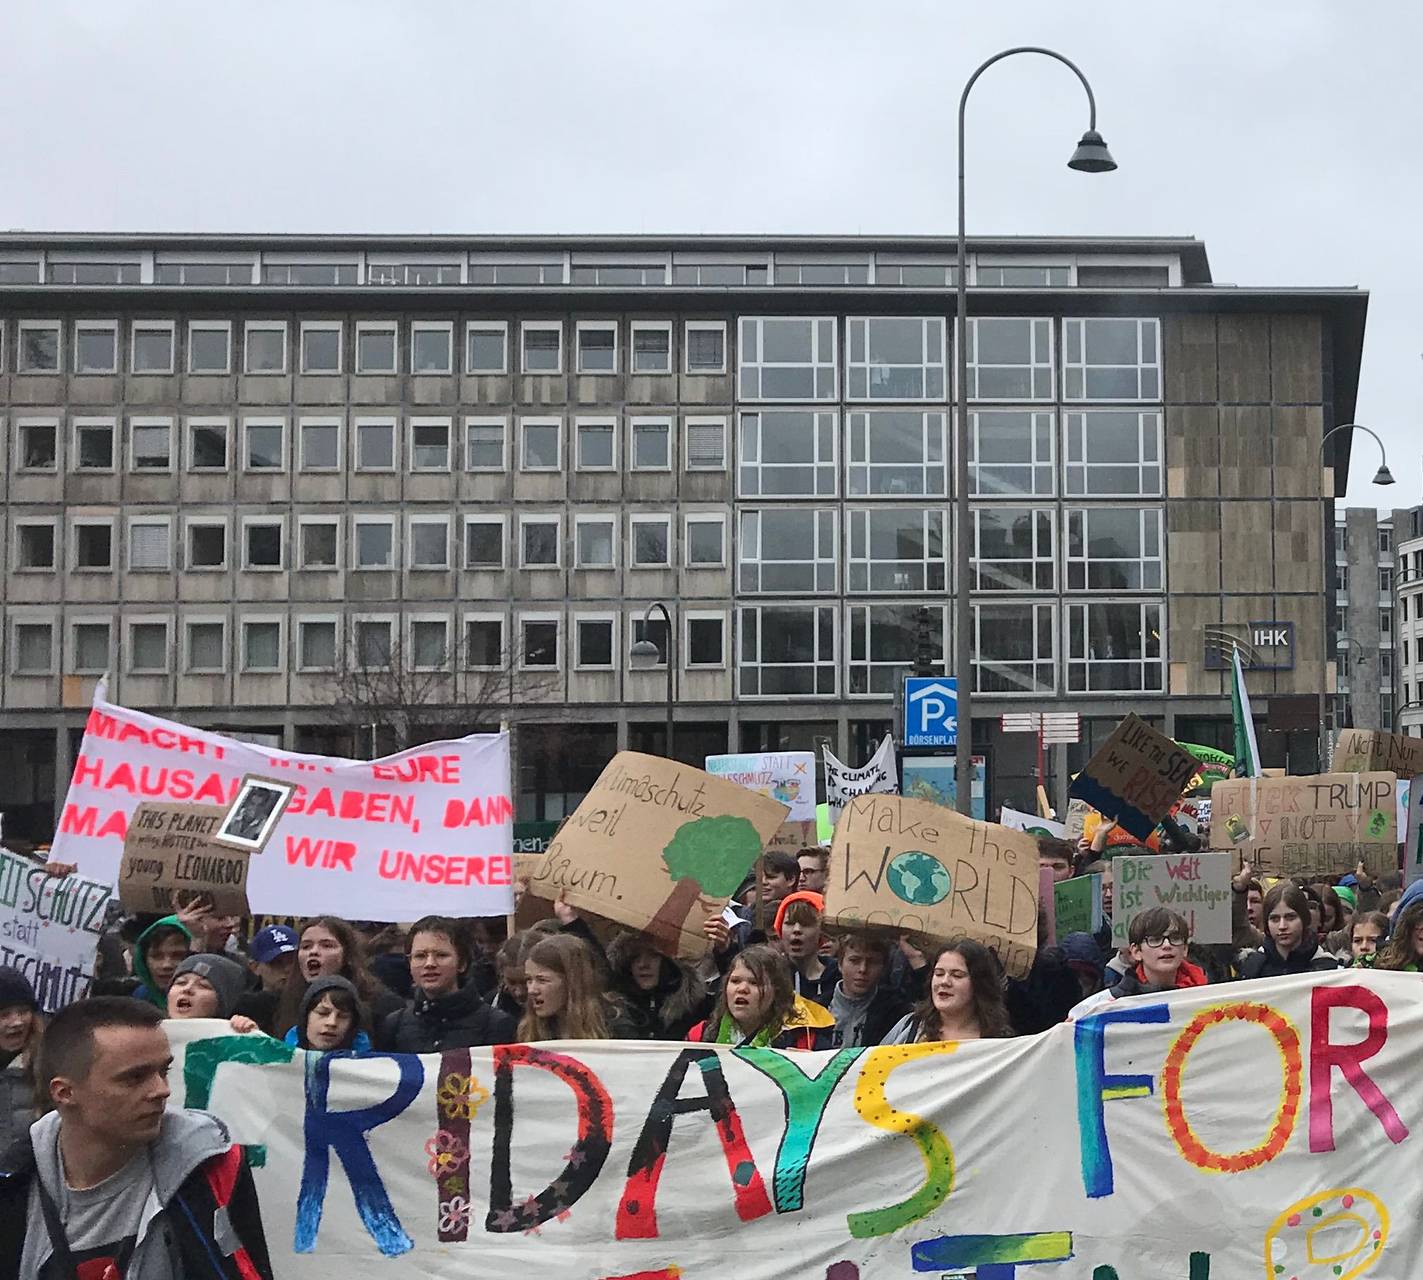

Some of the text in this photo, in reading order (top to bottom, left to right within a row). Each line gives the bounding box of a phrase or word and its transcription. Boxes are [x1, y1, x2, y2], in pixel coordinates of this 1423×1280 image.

[1254, 629, 1289, 646] IHK
[921, 697, 946, 732] P
[1120, 720, 1152, 754] LIKE
[762, 755, 793, 771] STATT
[1107, 751, 1132, 775] WE
[1307, 780, 1392, 811] TRUMP
[137, 809, 220, 835] THIS PLANET
[846, 796, 940, 843] Make
[966, 822, 1018, 866] the
[1281, 814, 1337, 841] NOT
[126, 853, 244, 885] young LEONARDO
[285, 835, 357, 872] WIR
[378, 849, 513, 886] UNSERE!
[533, 841, 623, 901] Baum.
[1121, 856, 1202, 884] Die Welt
[1119, 886, 1143, 910] ist
[3, 915, 40, 948] statt
[1073, 985, 1410, 1199] FOR
